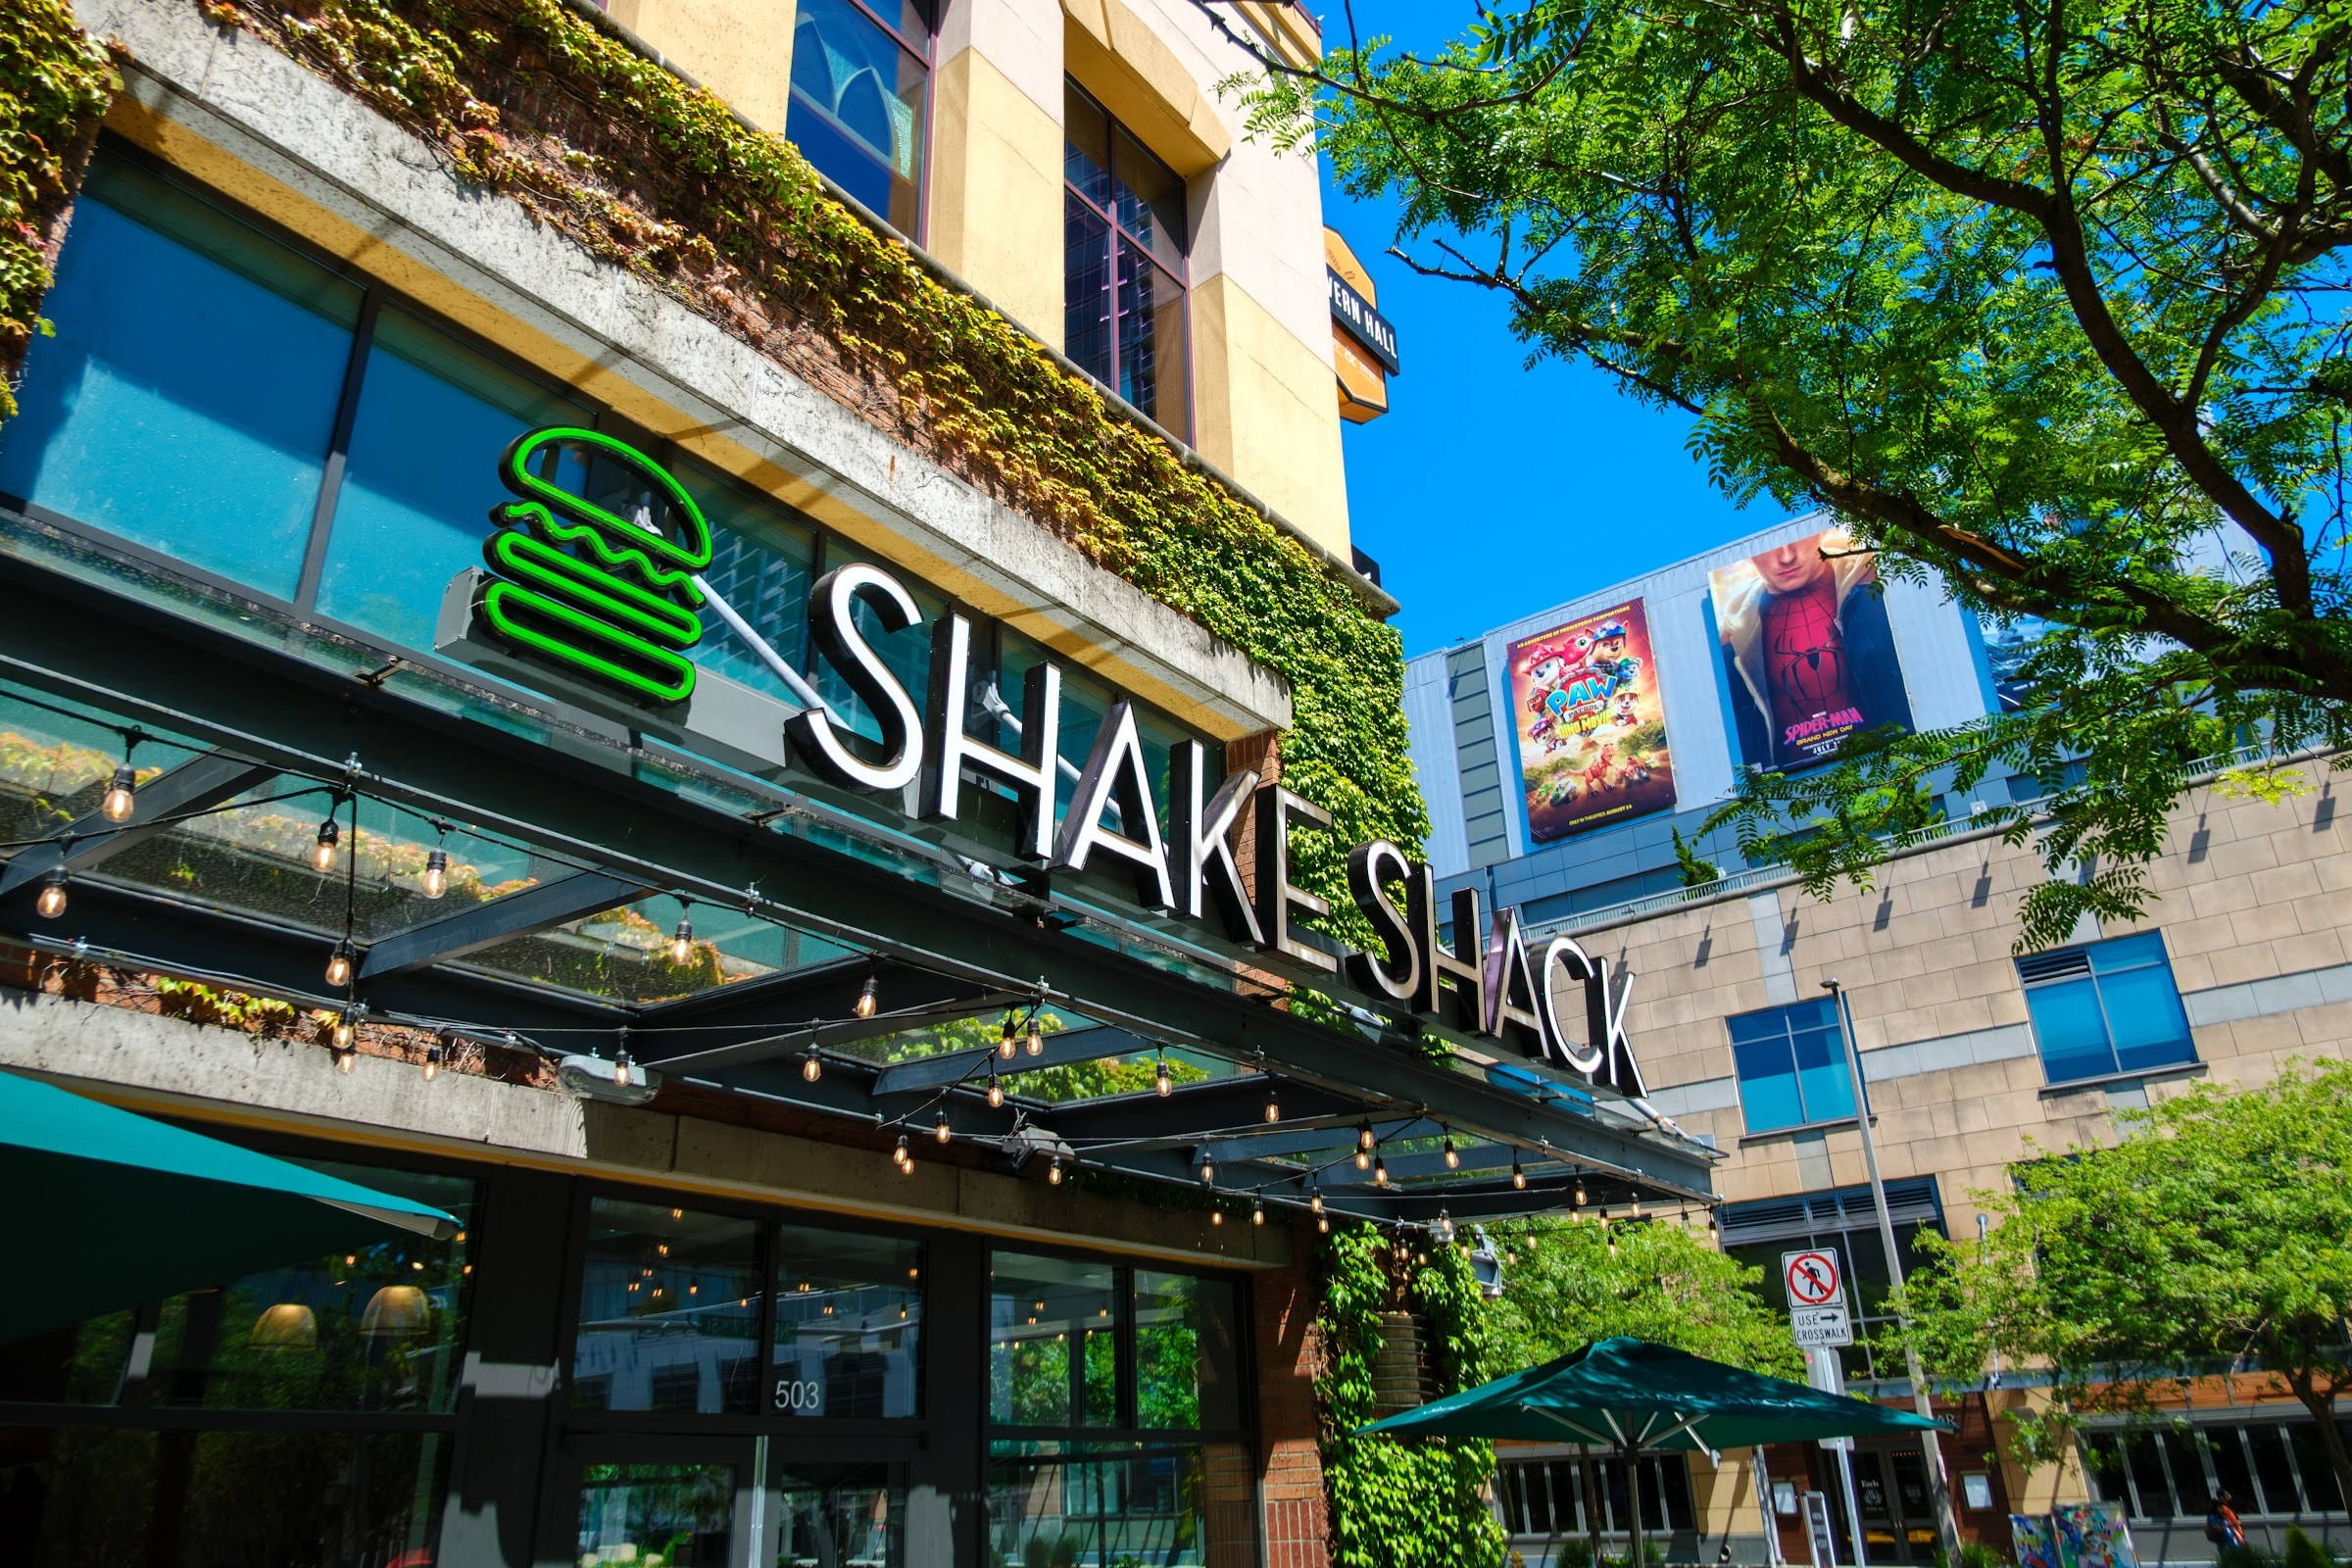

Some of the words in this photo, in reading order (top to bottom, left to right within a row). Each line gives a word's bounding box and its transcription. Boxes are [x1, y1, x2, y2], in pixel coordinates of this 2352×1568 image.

[1364, 310, 1397, 359] HALL
[1524, 632, 1552, 647] ADVENTURE
[1560, 618, 1593, 634] PREHISTORIC
[1545, 674, 1618, 716] PAW
[1556, 719, 1581, 739] DINO
[1582, 709, 1613, 732] MOVIE
[1568, 704, 1599, 718] PATROL
[1784, 707, 1864, 745] SPIDER-MAN
[1795, 734, 1821, 746] BRAND
[1823, 729, 1838, 738] NEW
[1839, 724, 1853, 733] DAY
[1812, 744, 1830, 755] JULY
[1606, 806, 1626, 815] AUGUST
[784, 562, 1339, 974] SHAKE
[1345, 839, 1648, 1099] SHACK
[1796, 1327, 1846, 1341] CROSSWALK
[1798, 1315, 1819, 1326] USE
[775, 1381, 819, 1408] 503
